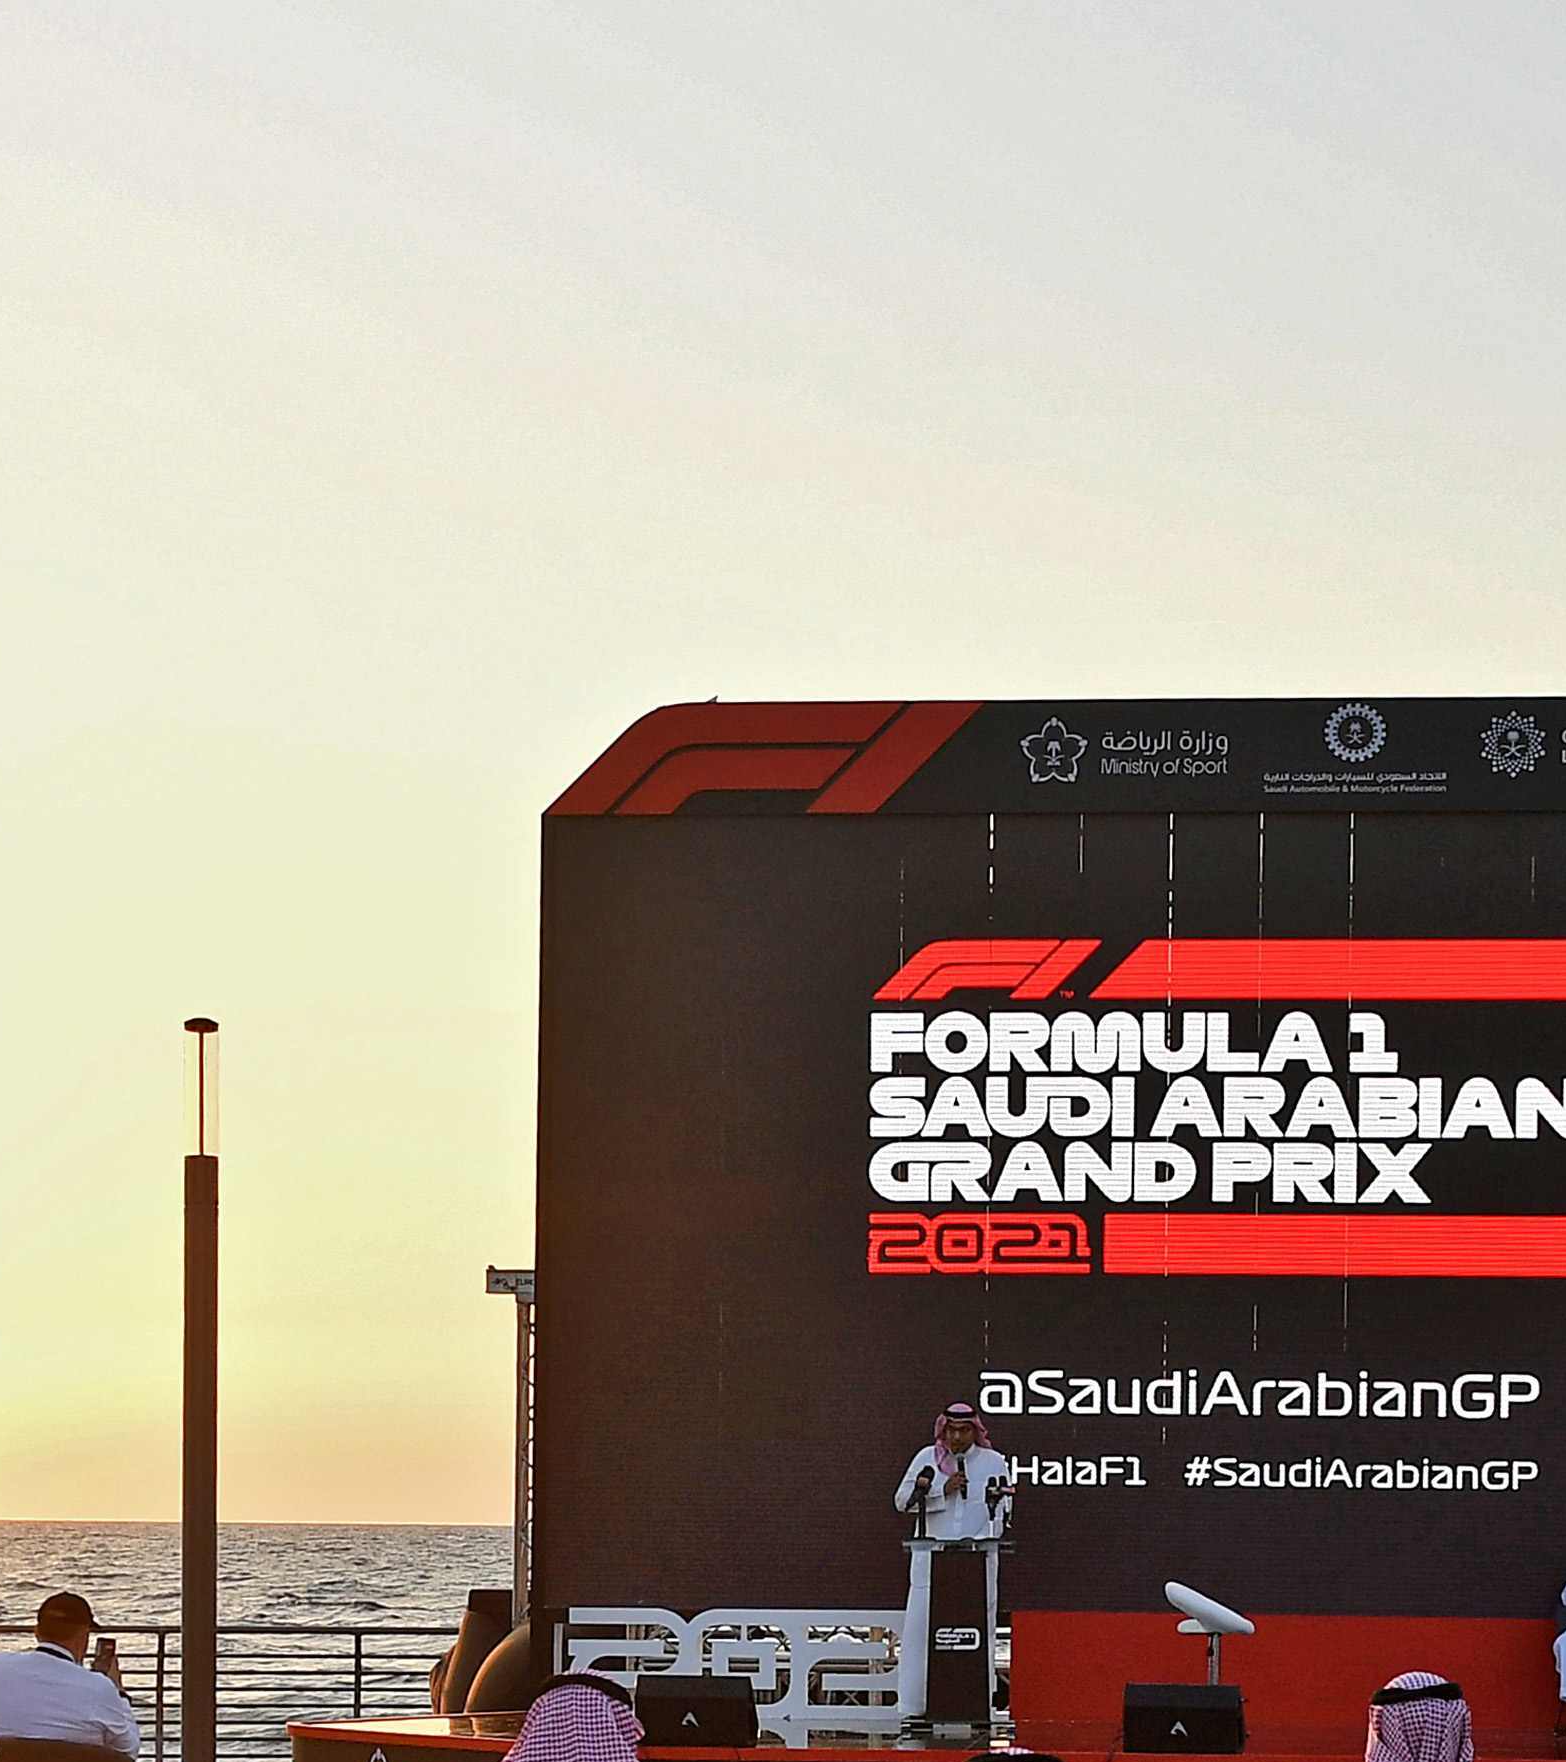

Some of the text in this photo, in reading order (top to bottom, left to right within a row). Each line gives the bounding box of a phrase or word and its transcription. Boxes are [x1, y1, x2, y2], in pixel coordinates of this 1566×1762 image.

[1100, 757, 1228, 777] Ministry of Sport
[1101, 730, 1229, 756] وزارة الرياضة
[868, 1010, 1398, 1074] FORMULA 1
[868, 1076, 1135, 1138] SAUDI
[867, 1141, 1433, 1205] GRAND PRIX
[868, 1212, 1091, 1274] 2021
[979, 1368, 1541, 1419] @SaudiArabianGP
[1010, 1455, 1538, 1491] HalaF1 #SaudiArabianGP
